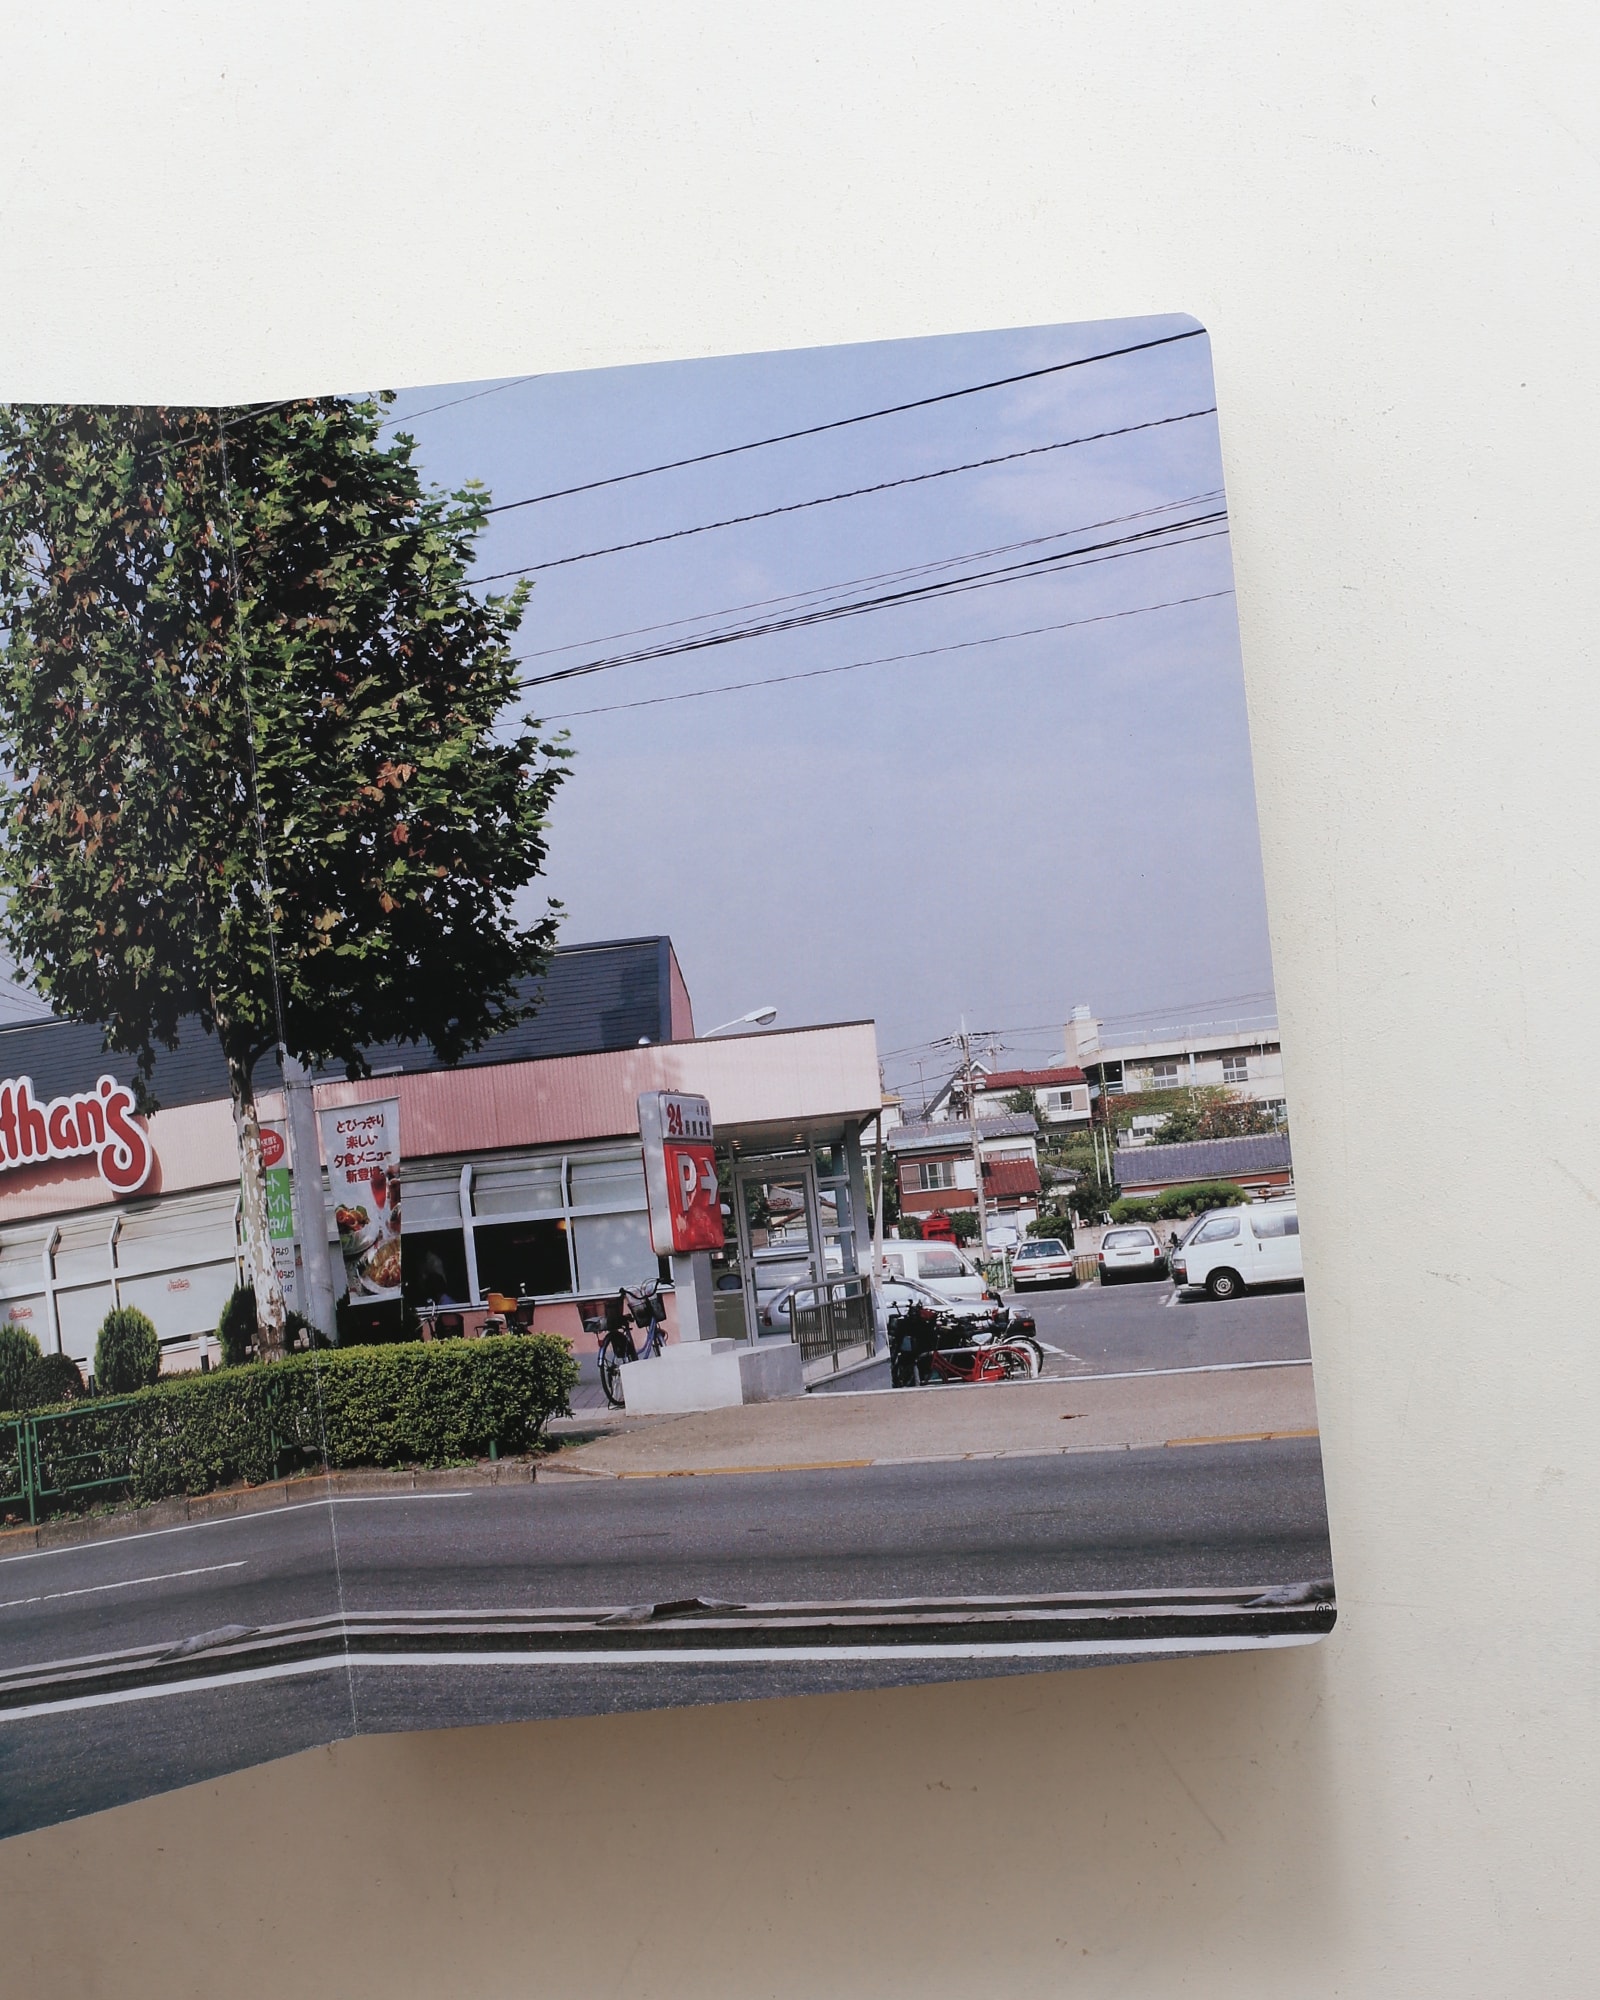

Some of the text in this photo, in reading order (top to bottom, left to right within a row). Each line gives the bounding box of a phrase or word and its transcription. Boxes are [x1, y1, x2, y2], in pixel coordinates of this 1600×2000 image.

[0, 1079, 148, 1189] than's
[346, 1135, 378, 1149] 楽しい
[334, 1151, 391, 1168] 夕食メニュー
[675, 1153, 697, 1212] P
